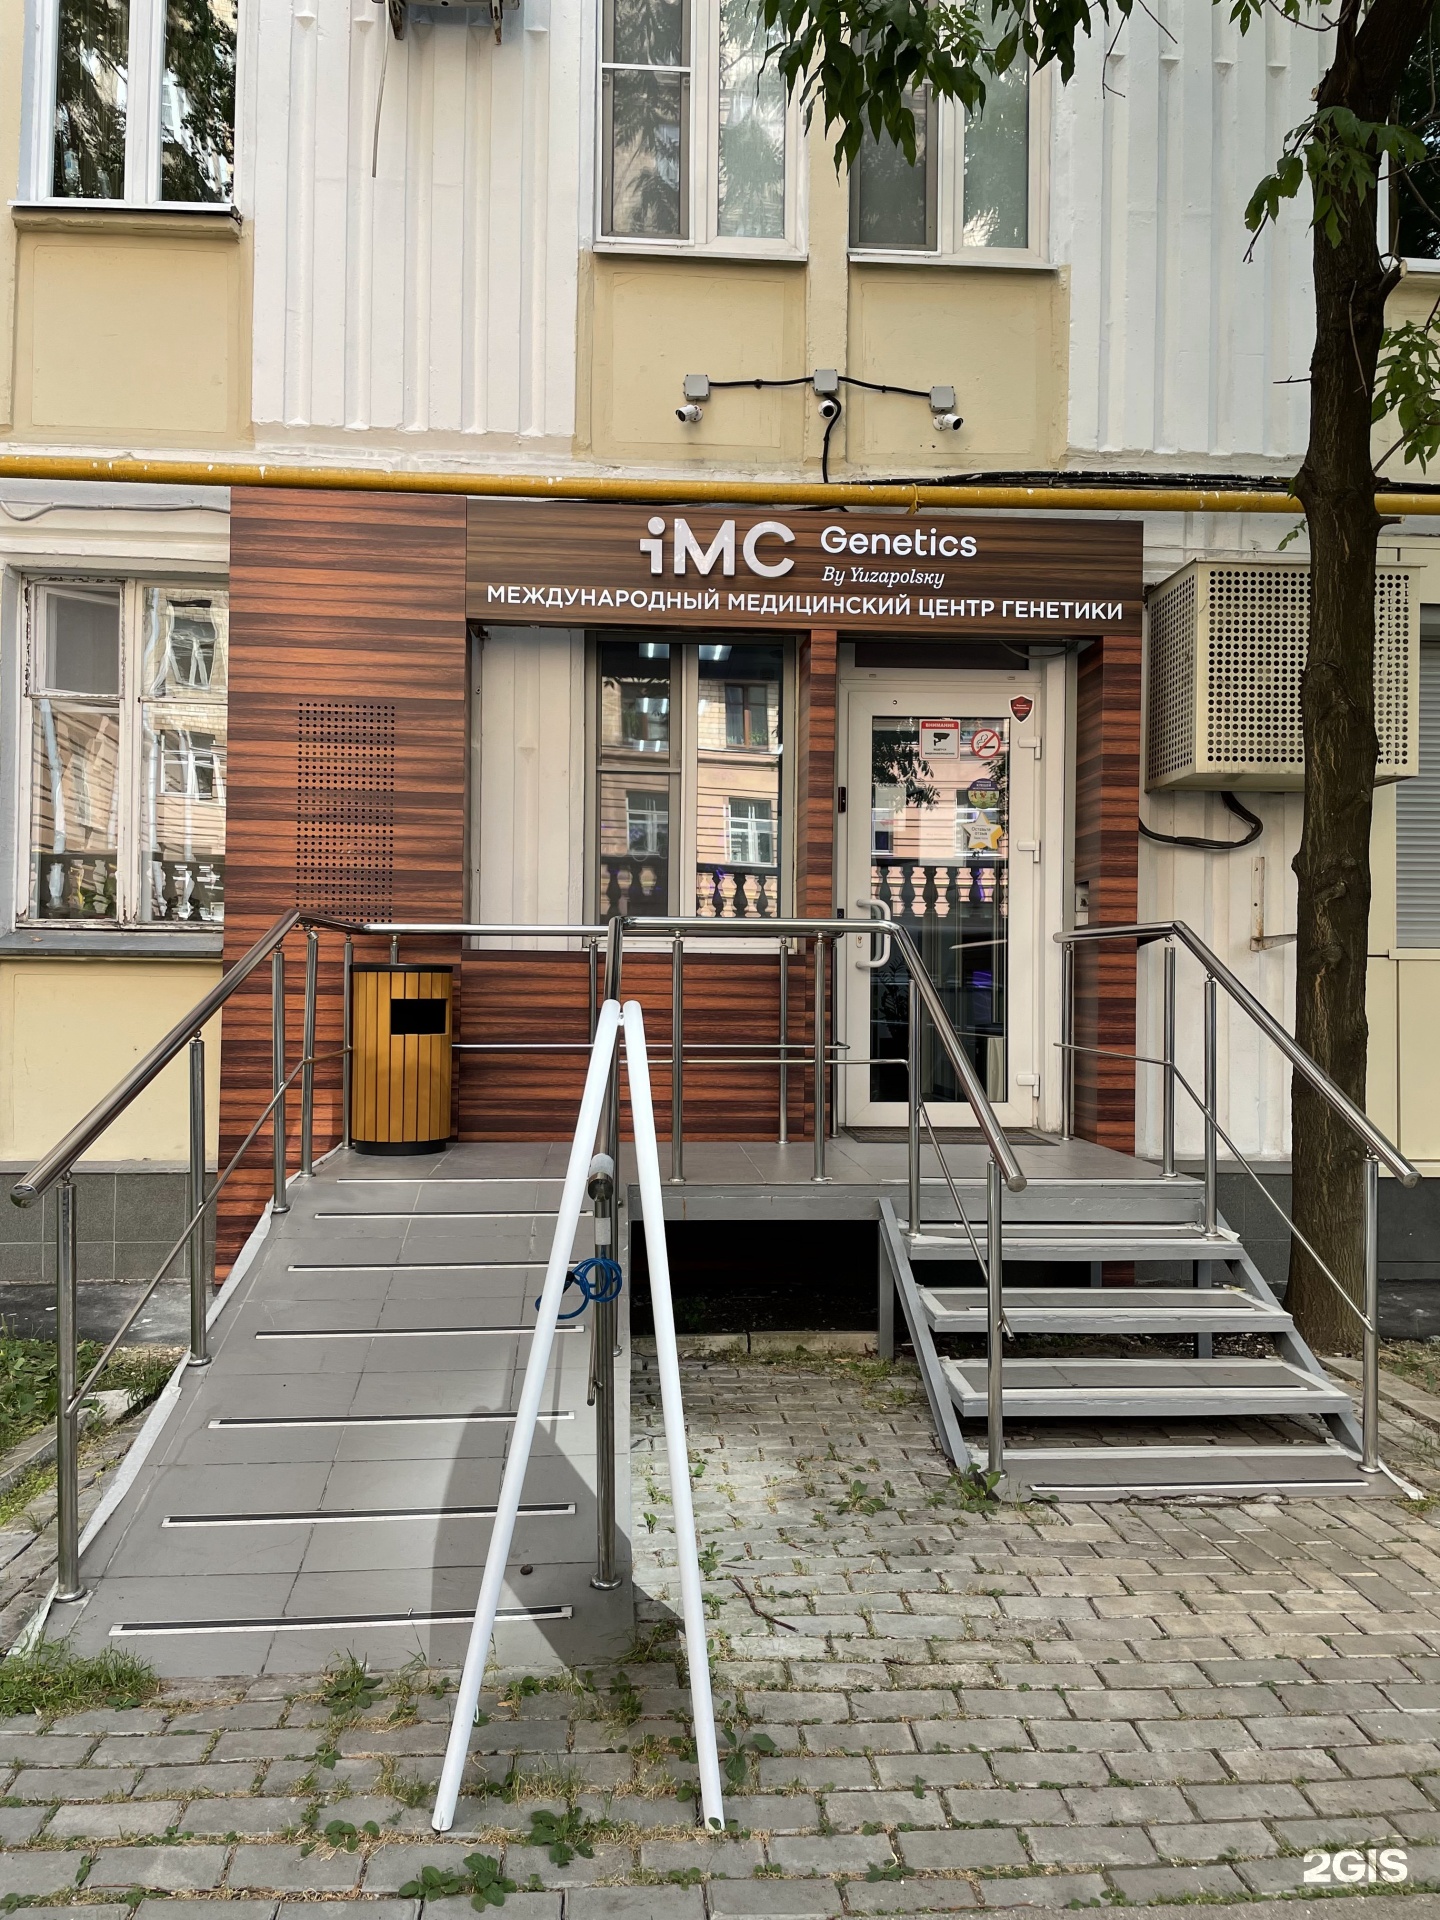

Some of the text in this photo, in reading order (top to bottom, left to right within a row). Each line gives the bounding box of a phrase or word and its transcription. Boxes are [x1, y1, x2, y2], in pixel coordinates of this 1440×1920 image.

[640, 516, 796, 578] iMC
[820, 525, 978, 557] Genetics
[821, 566, 945, 589] By Yuzapolsky
[487, 584, 1123, 620] МЕЖДУНАРОДНЫЙ МЕДИЦИНСКИЙ ЦЕНТР ГЕНЕТИКИ
